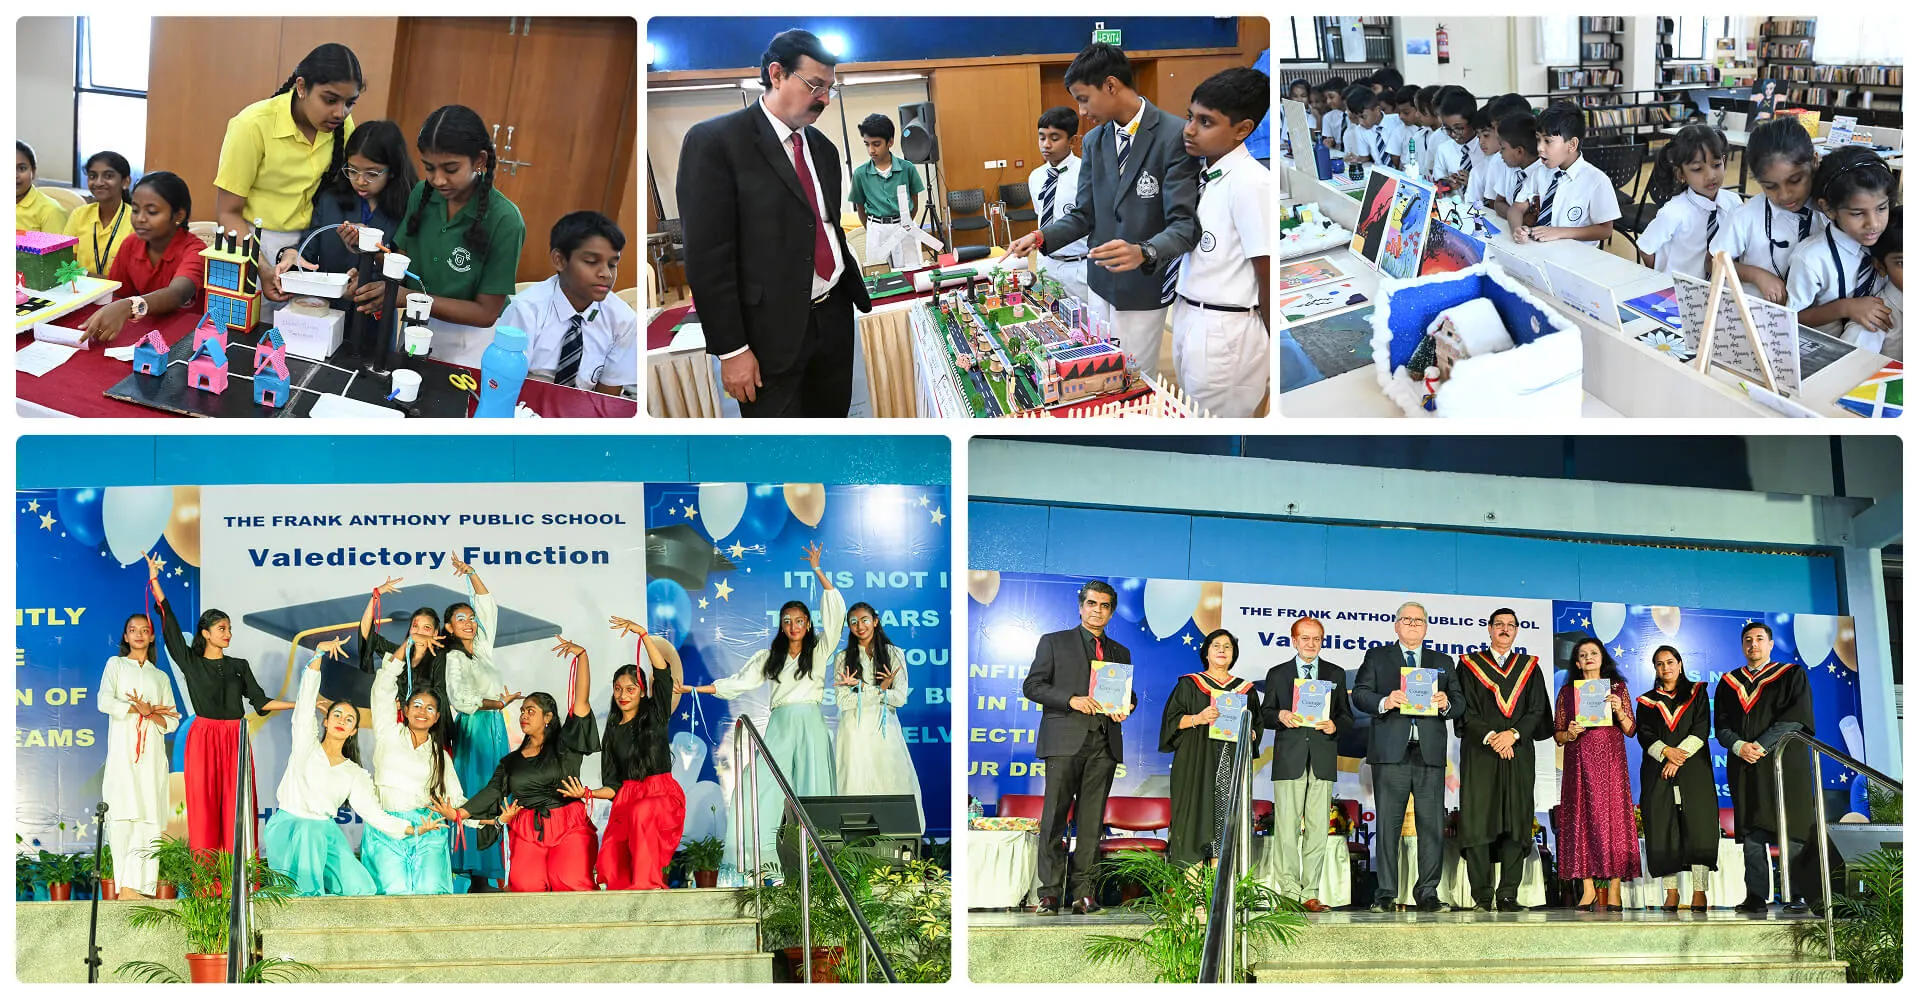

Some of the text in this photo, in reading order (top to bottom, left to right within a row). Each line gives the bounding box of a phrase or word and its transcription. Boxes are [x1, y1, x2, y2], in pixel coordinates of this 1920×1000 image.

[1102, 33, 1116, 43] EXIT
[224, 513, 626, 527] THE FRANK ANTHONY PUBLIC SCHOOL
[248, 545, 609, 570] Valedictory Function
[784, 571, 815, 589] IT
[866, 571, 928, 588] NOT
[1240, 607, 1272, 616] THE
[1278, 608, 1332, 619] FRANK
[1429, 616, 1474, 627] UBLIC
[45, 688, 88, 706] OF
[977, 696, 1006, 711] IN
